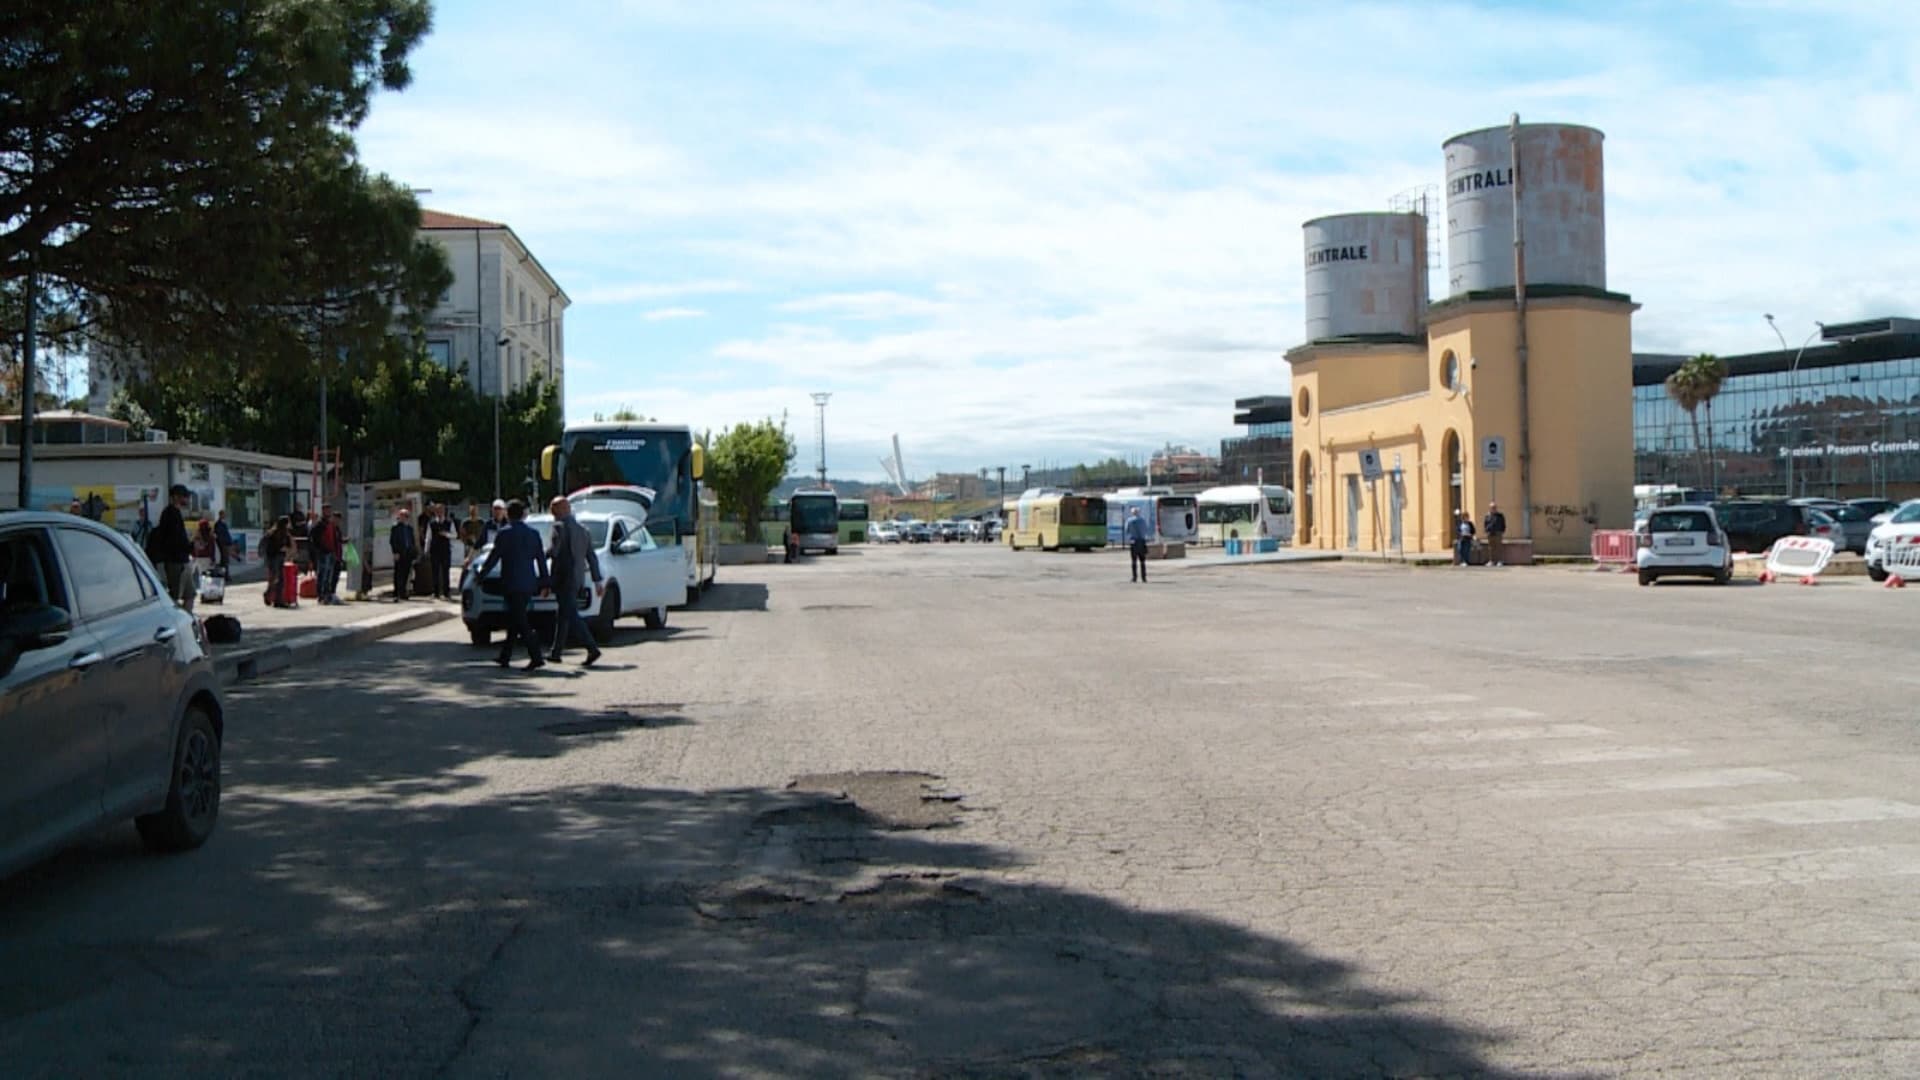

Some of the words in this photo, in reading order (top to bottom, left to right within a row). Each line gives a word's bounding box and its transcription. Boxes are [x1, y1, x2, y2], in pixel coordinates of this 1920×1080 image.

[1308, 245, 1368, 267] CENTRALE
[1826, 444, 1868, 454] Pescara
[1871, 439, 1919, 452] Centrale
